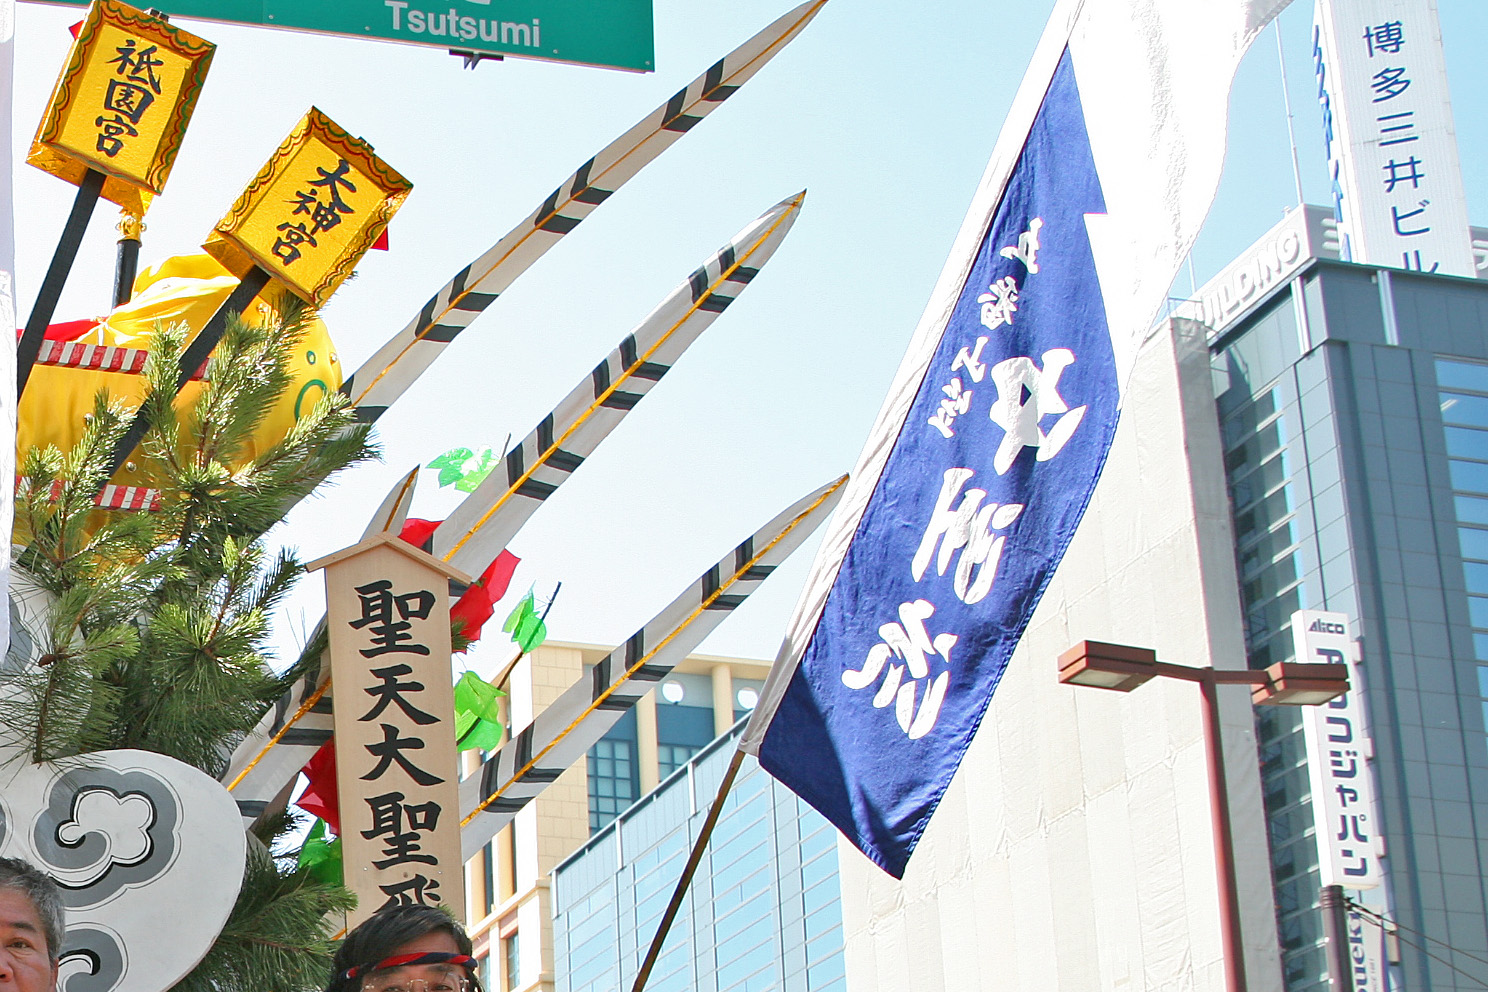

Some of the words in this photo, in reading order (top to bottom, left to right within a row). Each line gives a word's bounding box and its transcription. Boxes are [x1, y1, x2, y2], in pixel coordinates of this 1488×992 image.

[384, 0, 541, 48] Tsutsumi
[272, 159, 357, 266] 大神宮
[1194, 228, 1300, 329] UILDING
